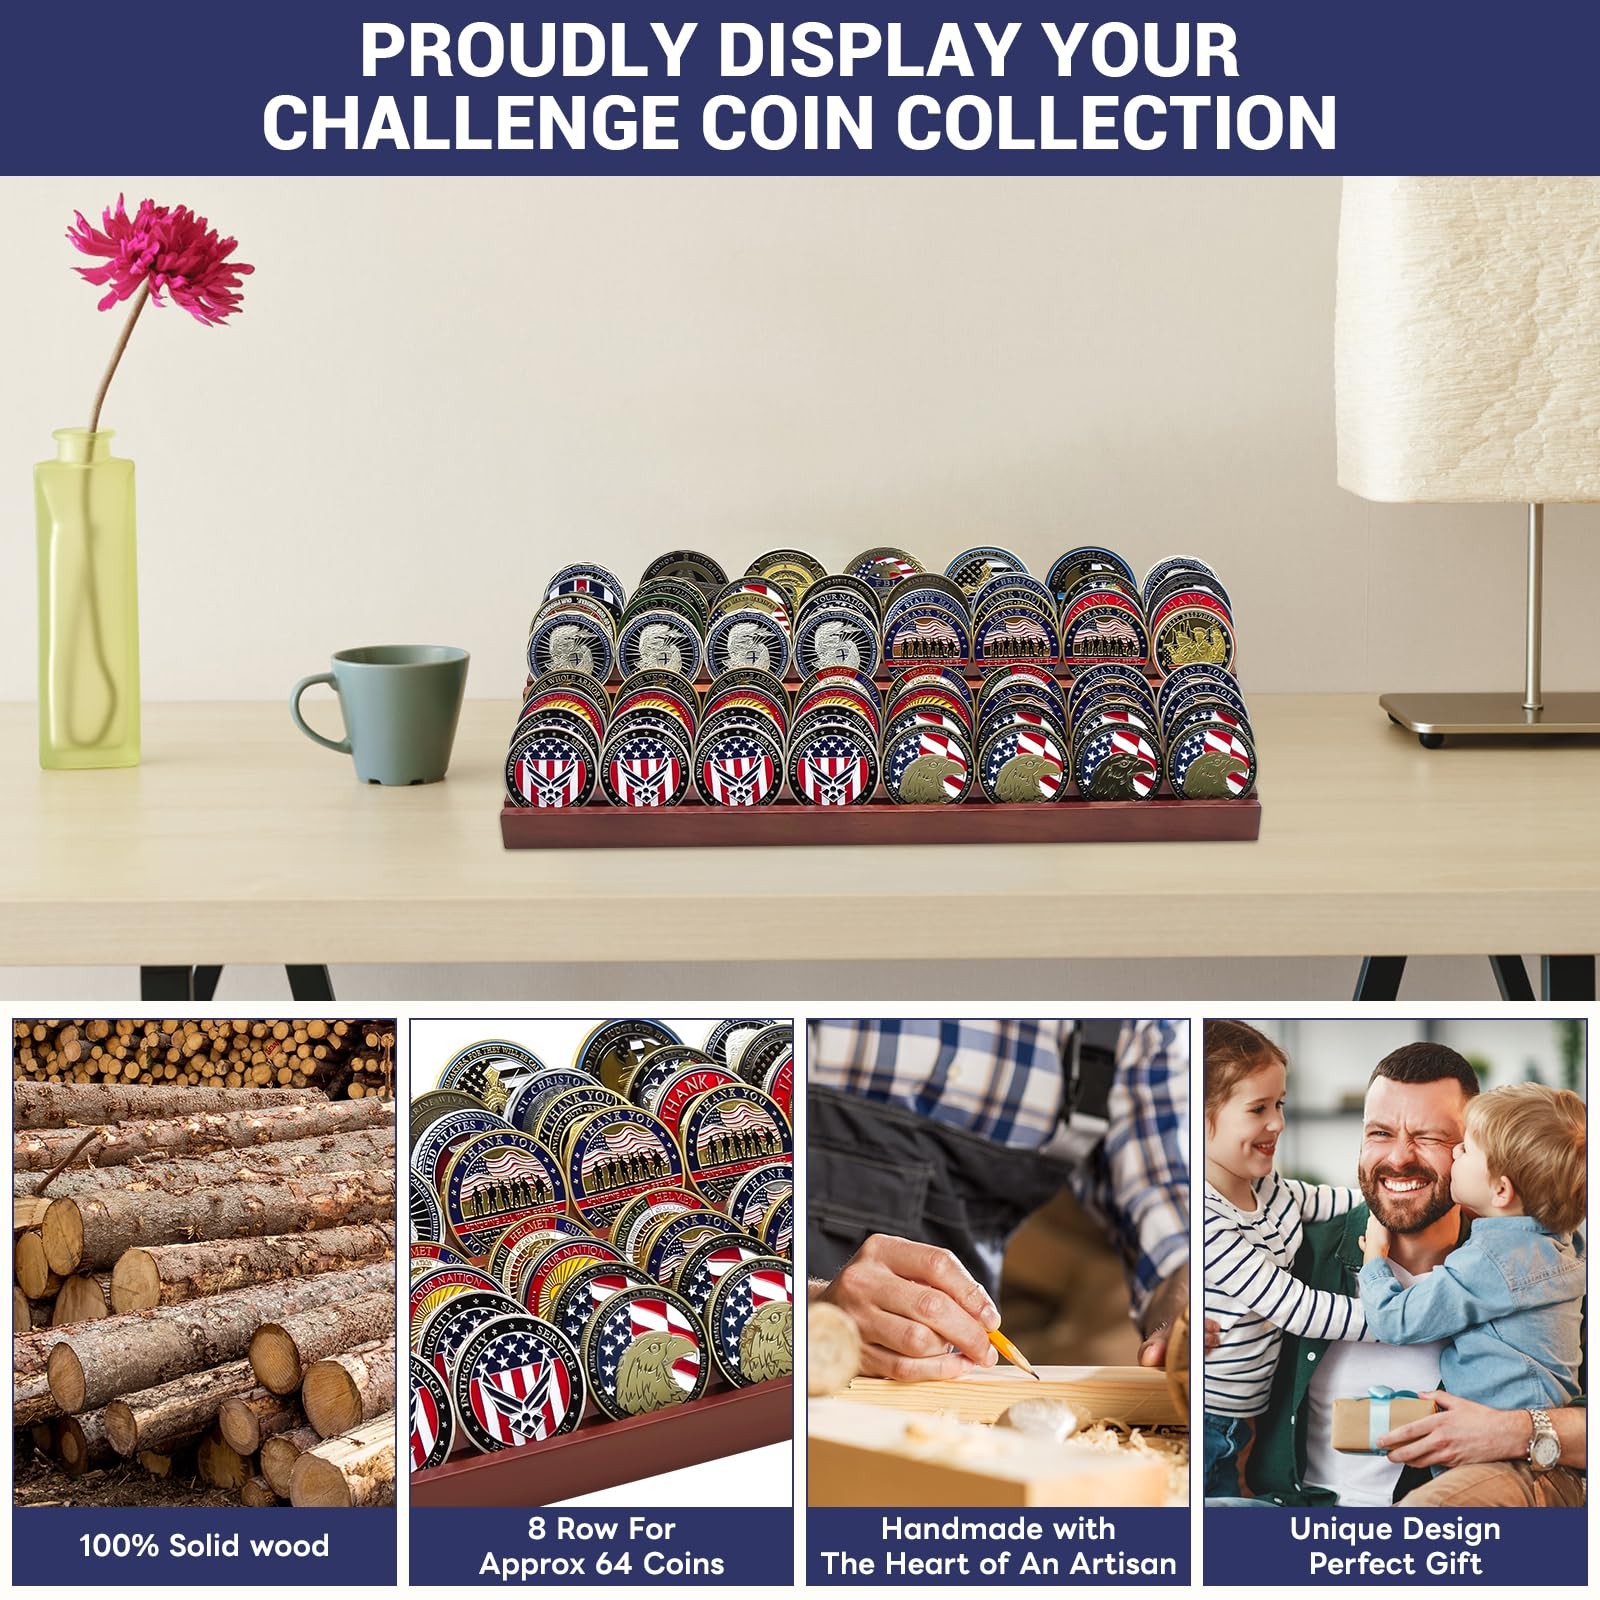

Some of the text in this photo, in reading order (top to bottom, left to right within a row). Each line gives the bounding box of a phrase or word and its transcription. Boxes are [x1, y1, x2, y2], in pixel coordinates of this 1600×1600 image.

[813, 594, 869, 614] YOUR NATION
[898, 608, 956, 626] THANK YOU
[988, 608, 1045, 625] THANK YOU
[1079, 607, 1136, 625] THANK YOU
[548, 673, 576, 686] WHOLE
[579, 675, 601, 699] ARMOR
[1086, 665, 1144, 686] THANK YOU
[1170, 665, 1227, 684] THANK YOU
[992, 685, 1027, 703] THANK
[1030, 687, 1051, 702] YOU
[1088, 685, 1145, 702] THANK YOU
[1176, 684, 1235, 701] THANK YOU
[507, 733, 593, 776] INTEGRITY SERVICE
[602, 733, 687, 778] INTEGRITY SERVICE
[696, 733, 780, 779] INTEGRITY SERVICE
[790, 731, 876, 775] INTEGRITY SERVICE
[531, 1074, 588, 1095] CHRISTO
[664, 1074, 709, 1121] THANK
[544, 1090, 614, 1127] THANK YOU
[696, 1087, 769, 1118] THANK YOU
[436, 1120, 476, 1146] STATES
[580, 1110, 655, 1143] THANK YOU
[460, 1134, 539, 1167] THANK YOU
[743, 1168, 785, 1196] THANK
[654, 1191, 694, 1207] HELMET
[509, 1218, 550, 1243] HELMET
[657, 1214, 732, 1249] THANK YOU
[537, 1253, 562, 1278] YOUR
[411, 1280, 436, 1305] YOUR
[423, 1307, 453, 1362] EGRITY
[411, 1359, 443, 1400] RVICE
[461, 1325, 577, 1409] INTEGRITY SERVICE
